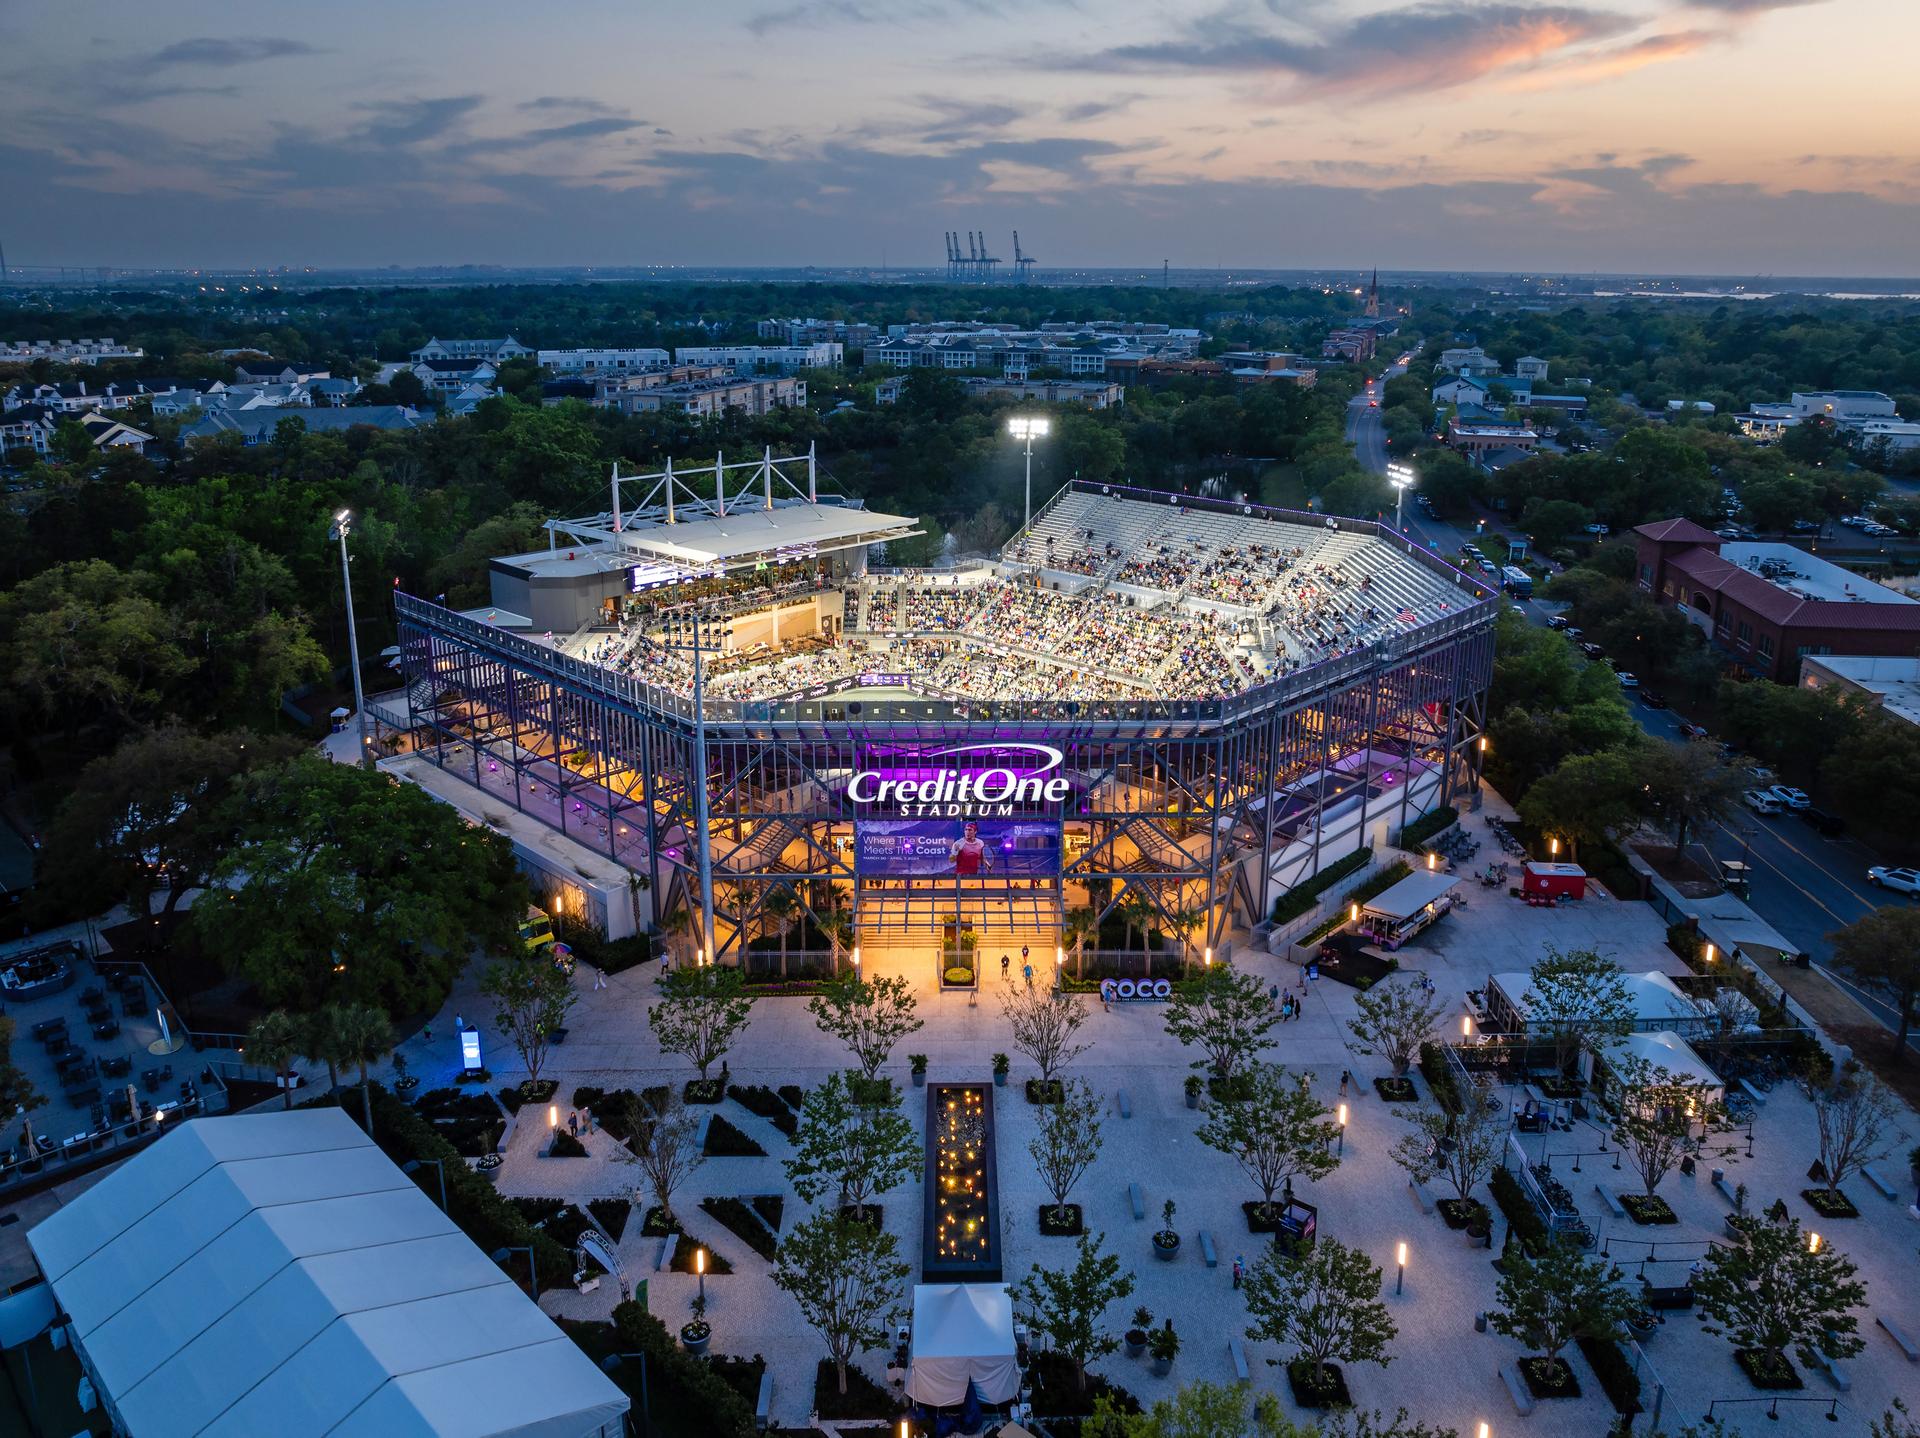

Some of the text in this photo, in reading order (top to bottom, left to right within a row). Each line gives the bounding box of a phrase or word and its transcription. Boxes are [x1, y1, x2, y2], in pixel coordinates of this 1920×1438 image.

[900, 804, 1013, 817] STADIUM
[863, 836, 947, 845] Where The Court
[863, 846, 946, 855] Meets The Coast
